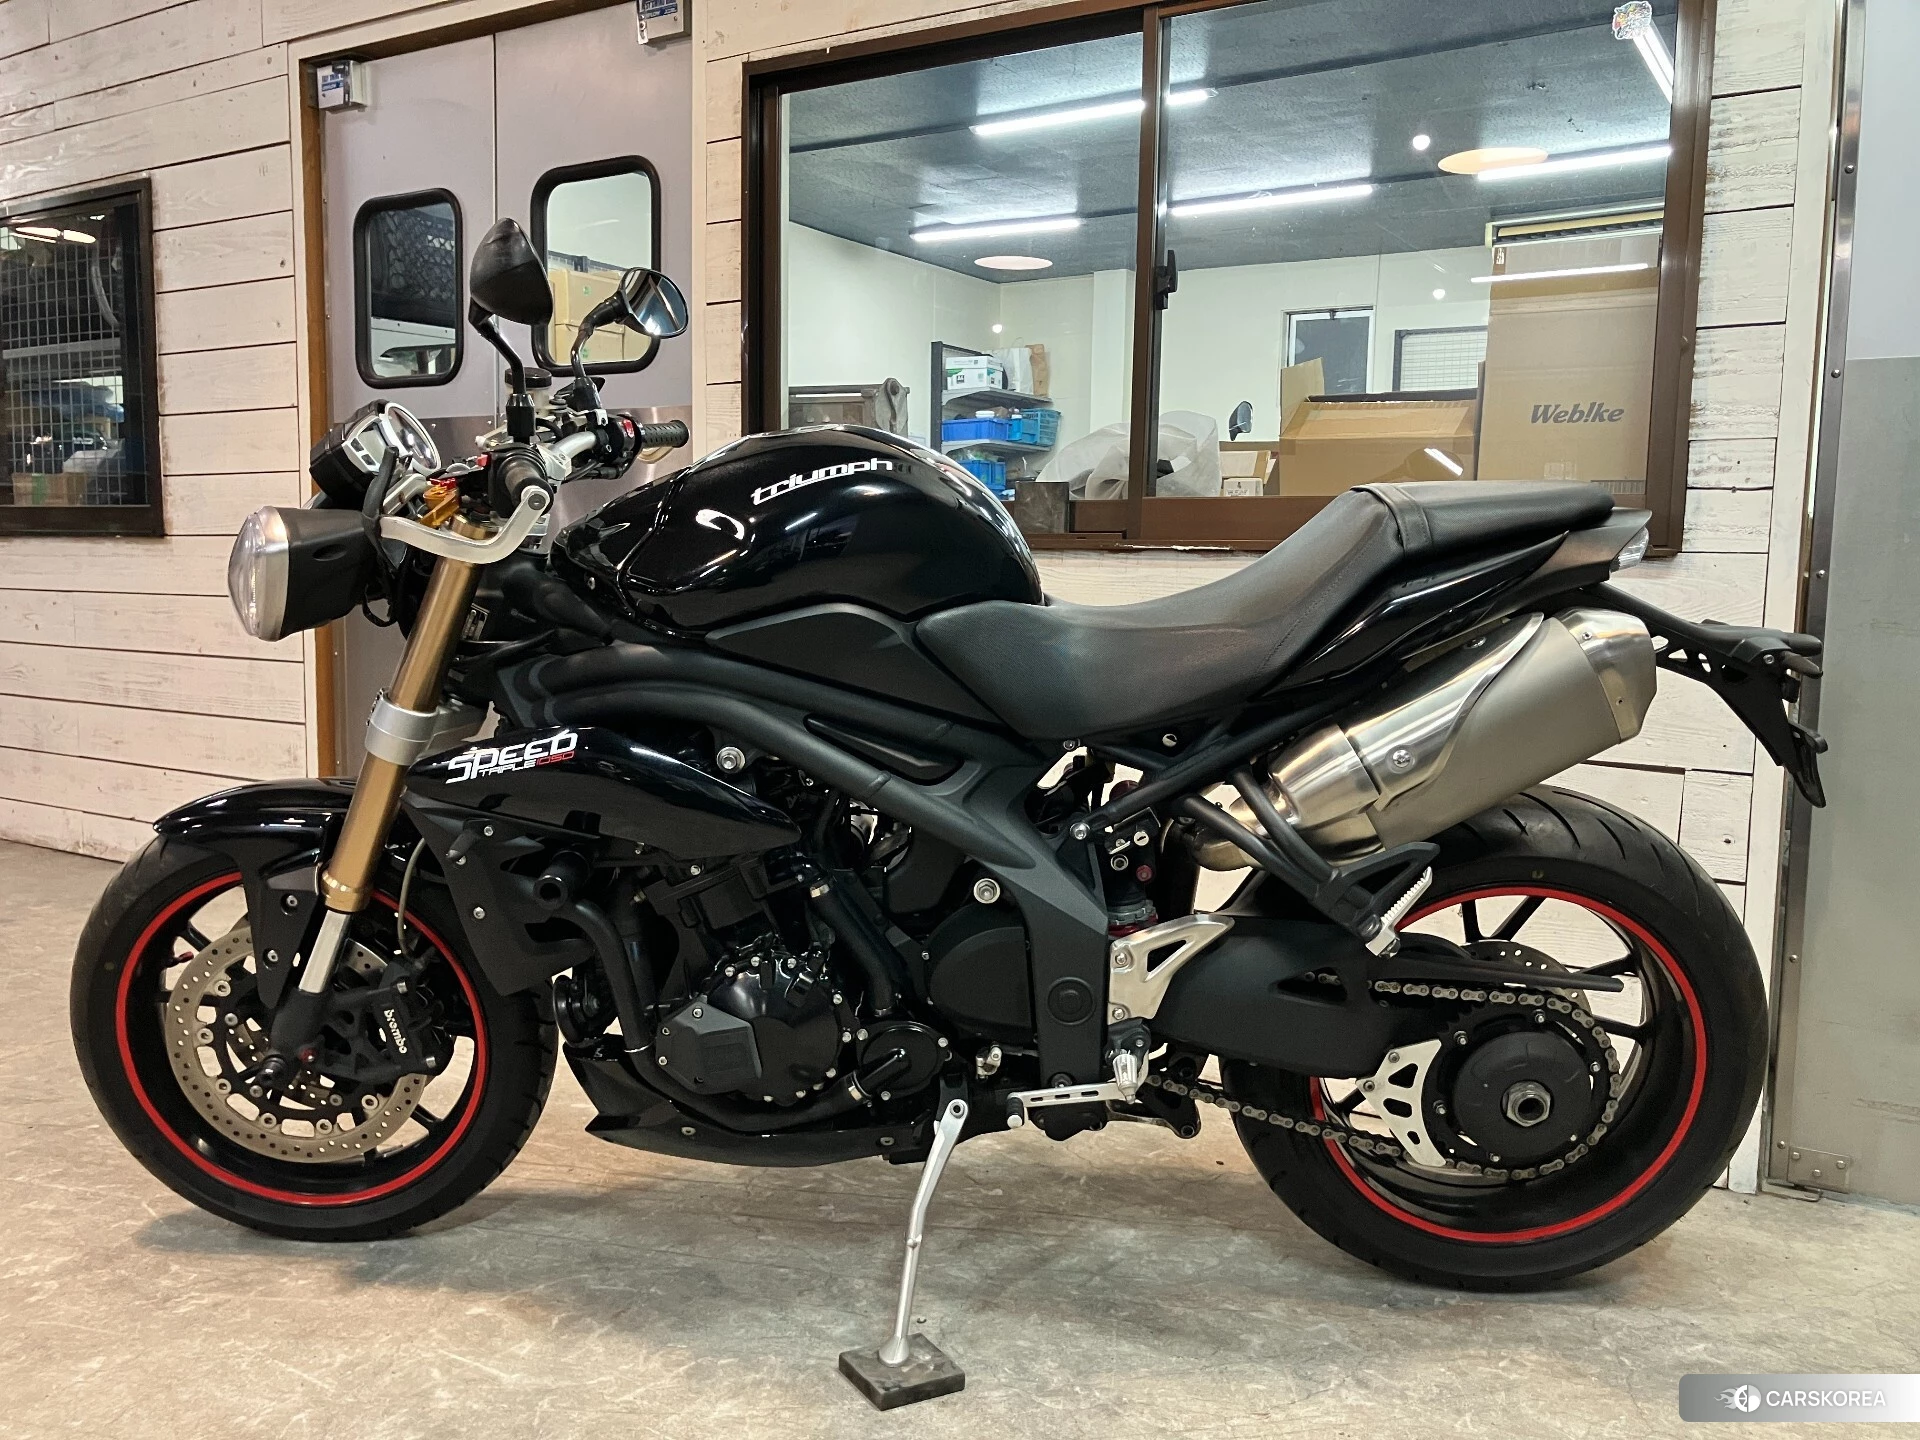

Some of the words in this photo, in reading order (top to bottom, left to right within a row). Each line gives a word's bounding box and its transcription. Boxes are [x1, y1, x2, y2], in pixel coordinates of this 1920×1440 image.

[445, 729, 578, 784] SPEED
[478, 759, 536, 777] TRIPLE
[536, 751, 575, 766] 1050
[383, 1009, 408, 1054] brembo
